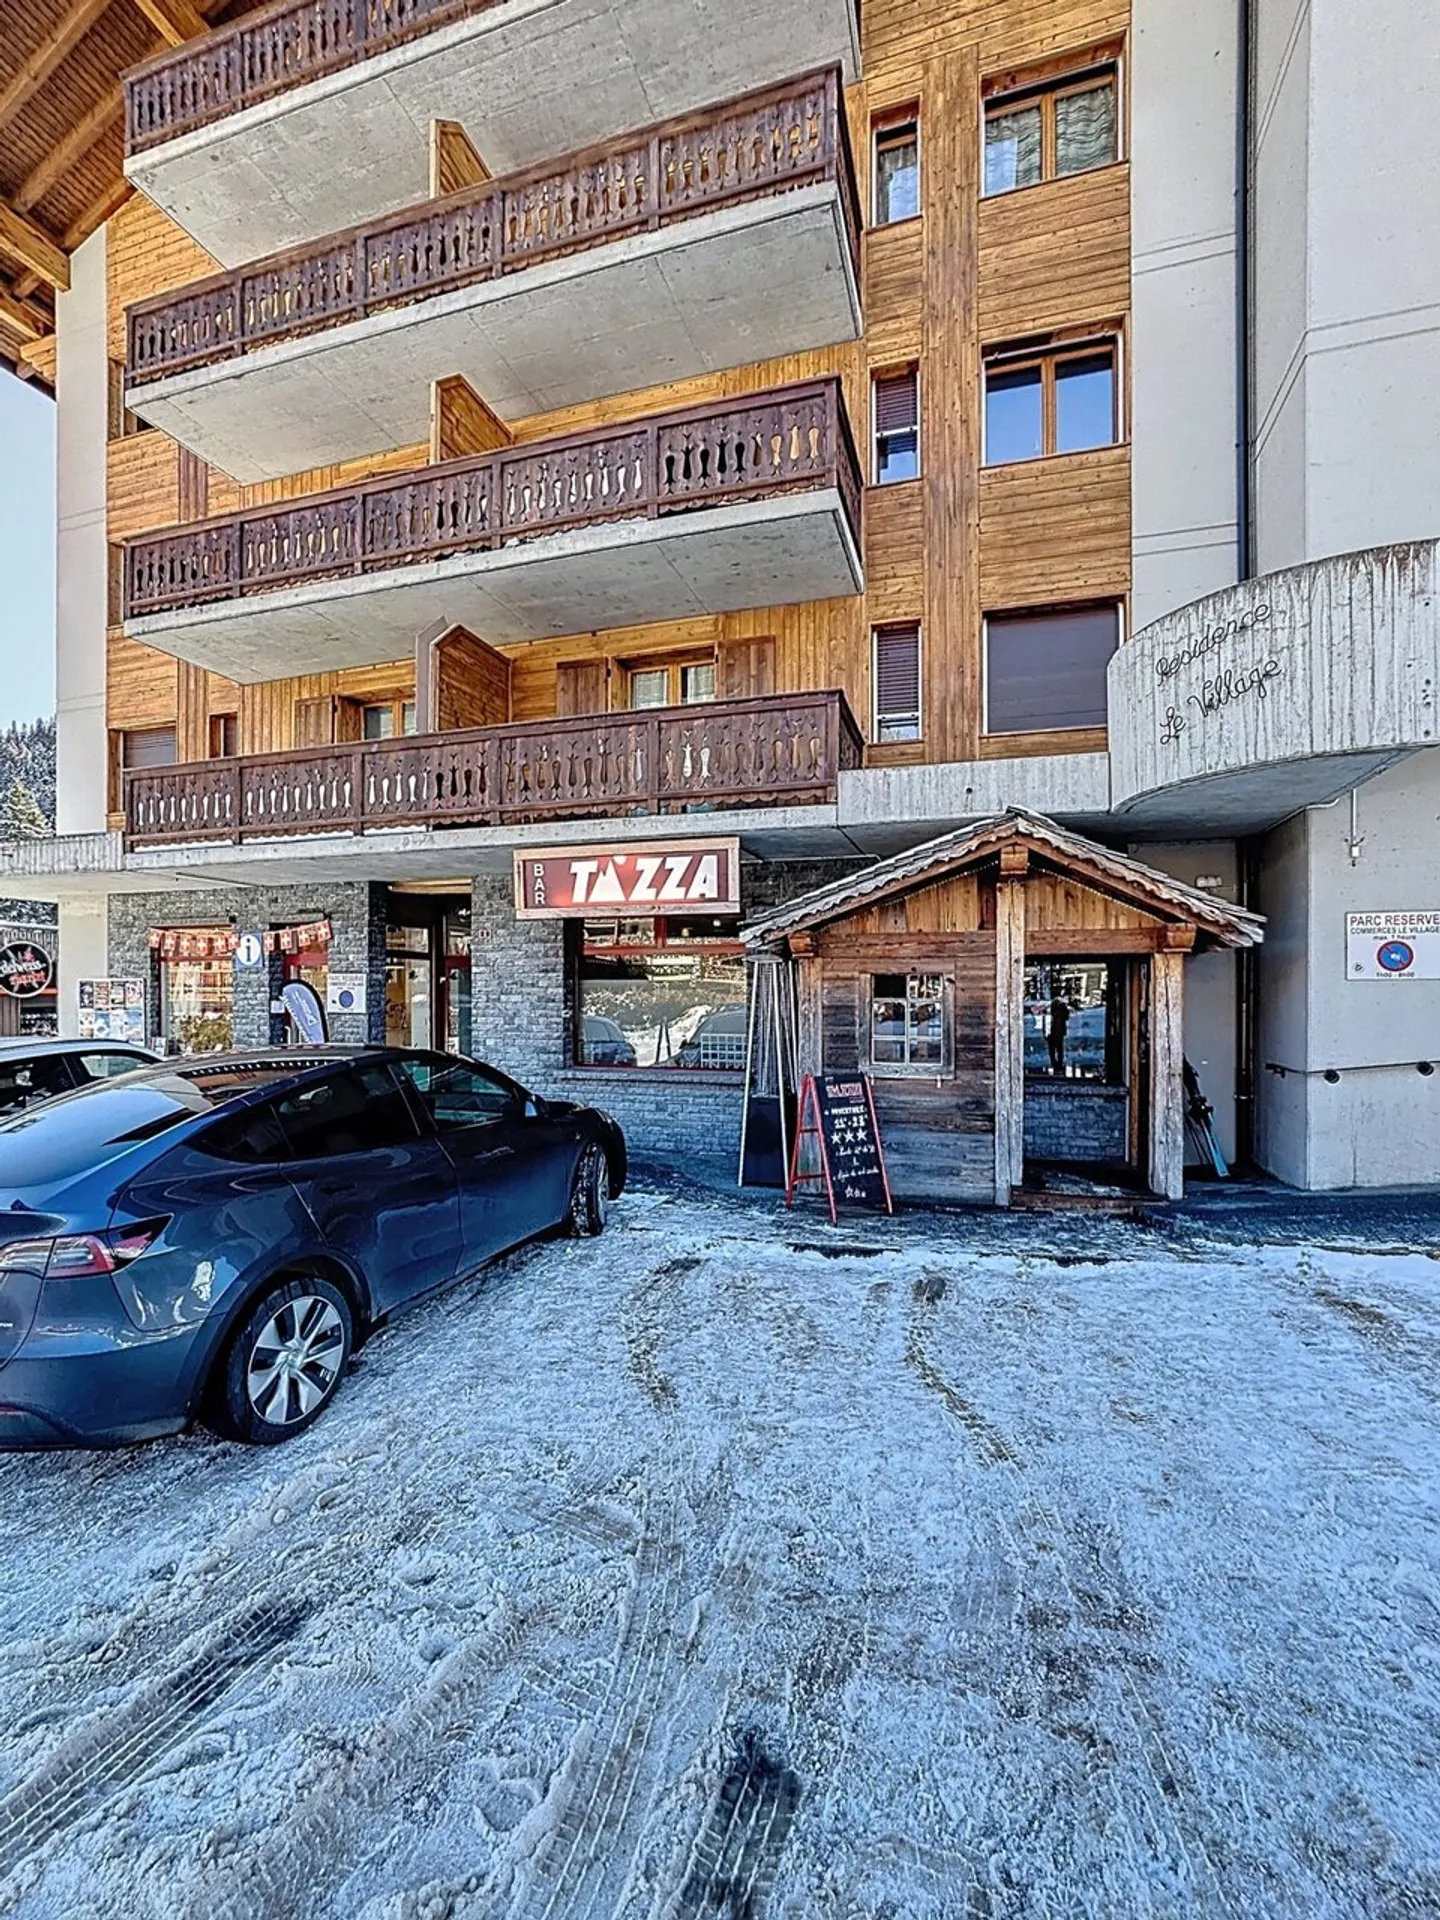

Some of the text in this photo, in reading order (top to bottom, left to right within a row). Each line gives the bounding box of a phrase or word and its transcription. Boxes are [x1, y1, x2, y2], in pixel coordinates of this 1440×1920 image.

[1160, 660, 1282, 745] Le Village
[533, 863, 546, 905] BAR
[569, 855, 719, 904] TAZZA
[1350, 914, 1440, 926] PARC RESERVE
[1350, 925, 1440, 935] COMMERCES LE VILLAGE
